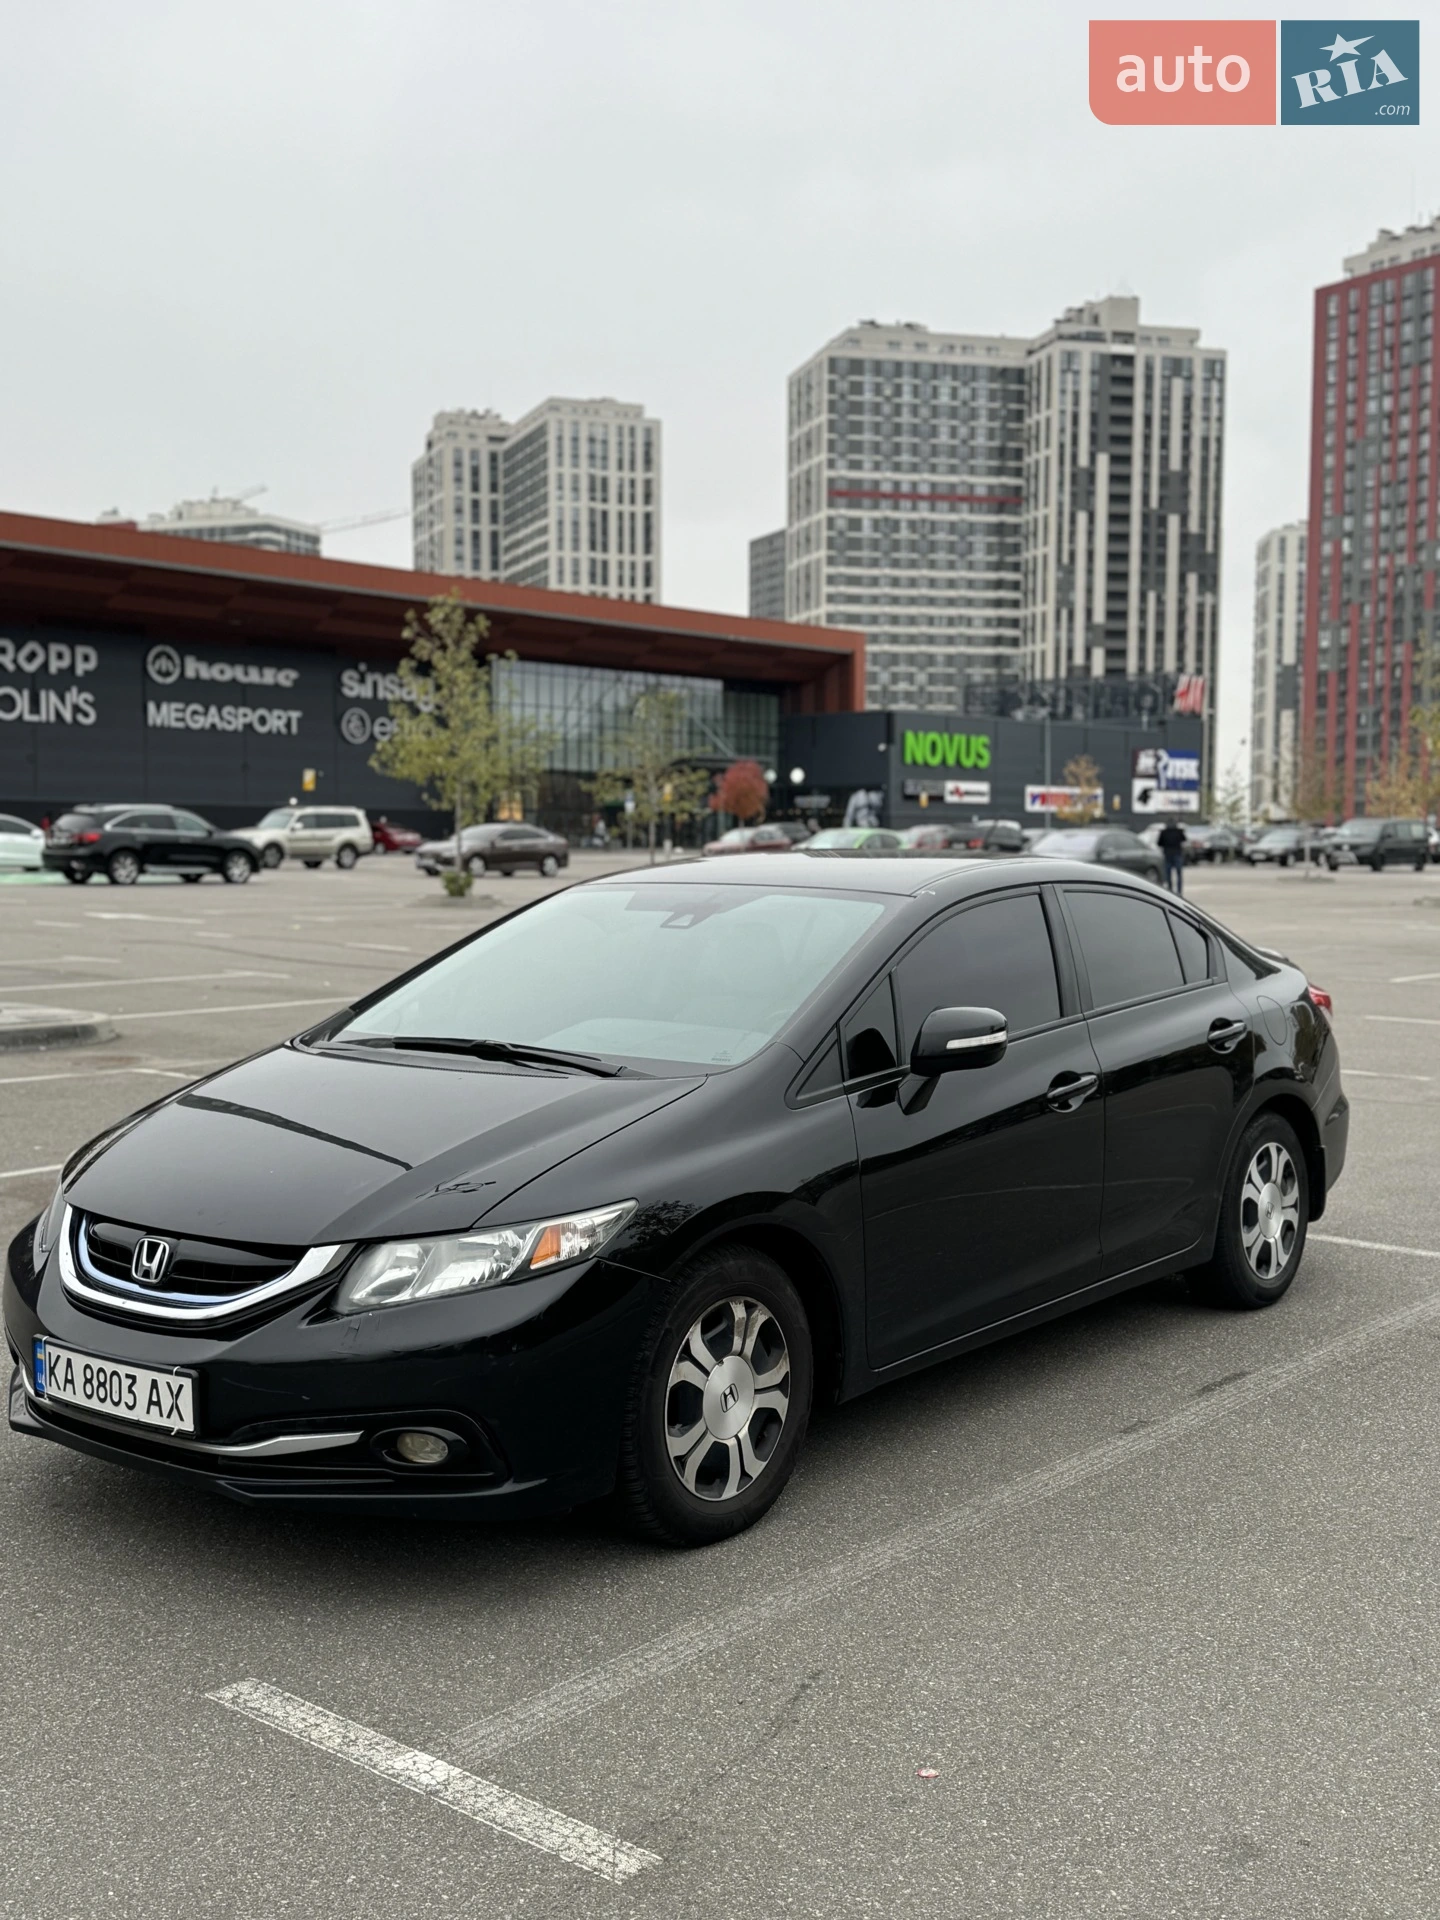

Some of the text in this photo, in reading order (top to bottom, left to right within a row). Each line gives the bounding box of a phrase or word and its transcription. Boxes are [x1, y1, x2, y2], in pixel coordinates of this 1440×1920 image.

[184, 654, 300, 688] house
[147, 699, 303, 736] MEGASPORT
[903, 729, 991, 770] NOVUS
[48, 1351, 184, 1422] KA 8803 AX
